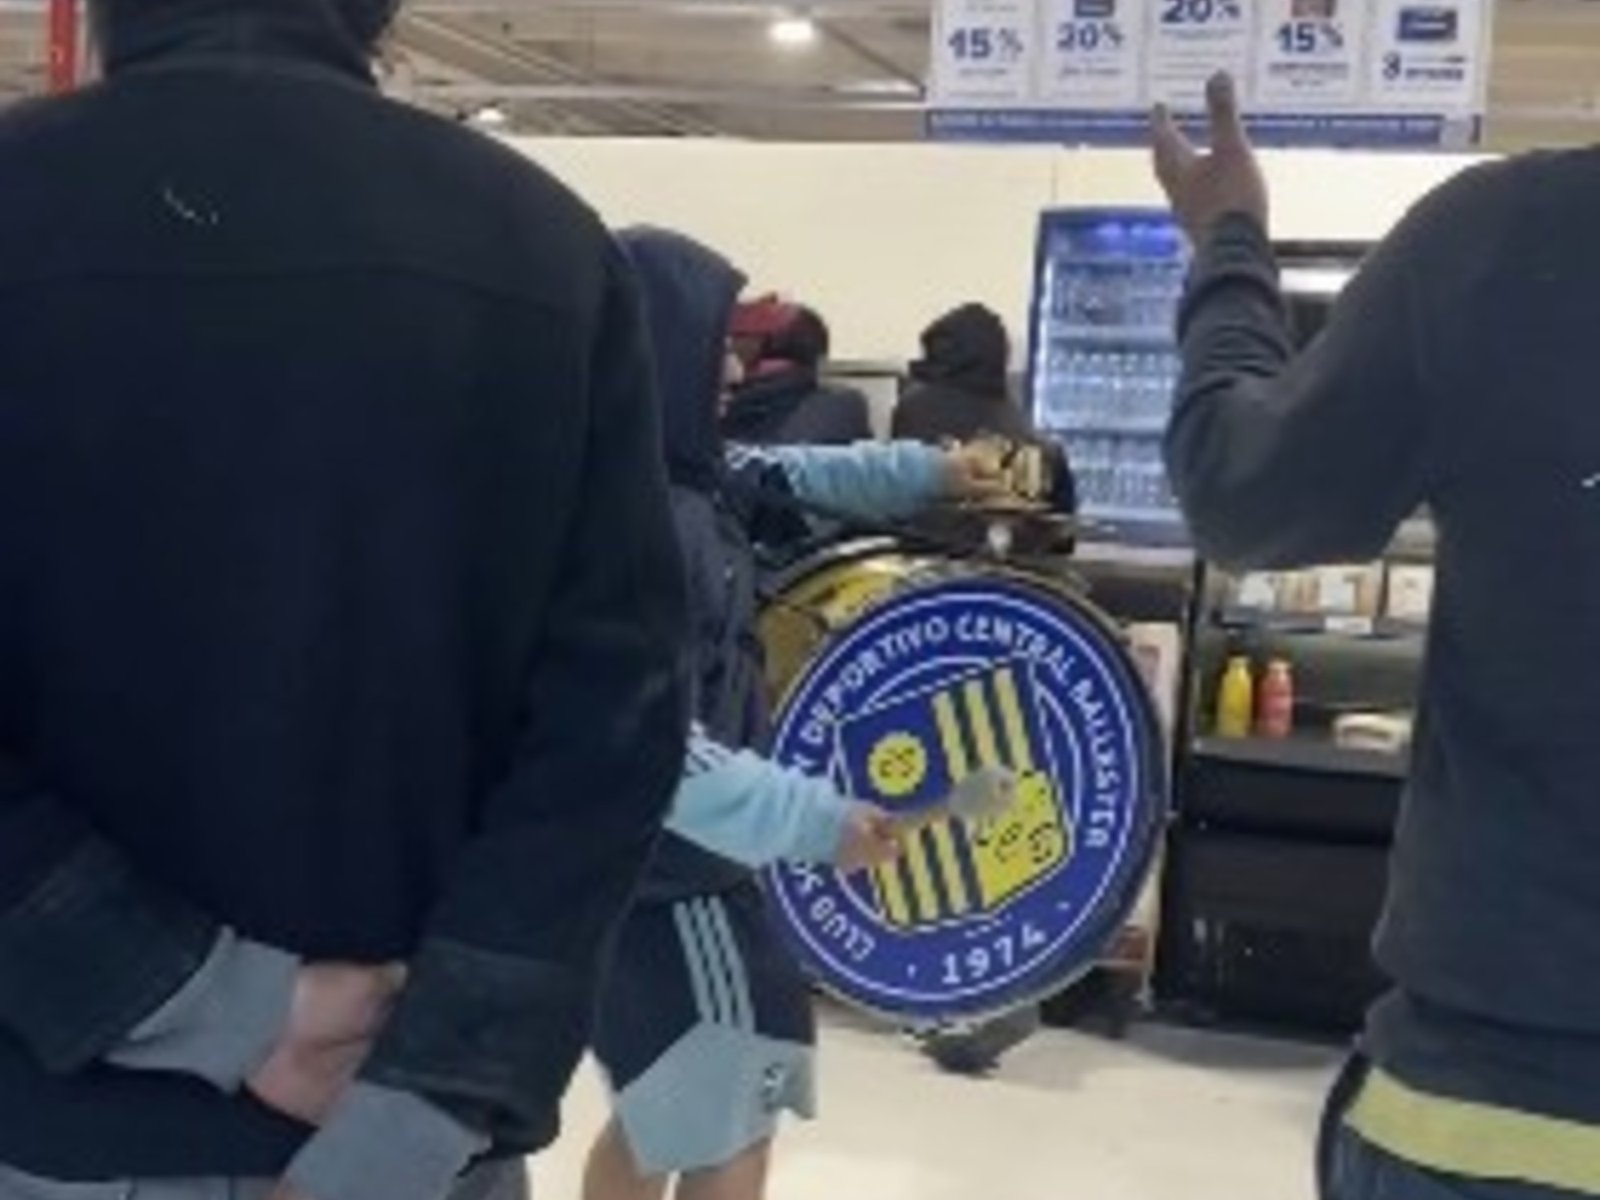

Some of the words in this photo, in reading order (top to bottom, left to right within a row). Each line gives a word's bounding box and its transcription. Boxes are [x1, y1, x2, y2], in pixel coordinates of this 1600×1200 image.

[800, 616, 949, 744] DEPORTIVO
[956, 611, 1076, 685] CENTRAL
[1068, 678, 1122, 848] BALLESTER
[811, 896, 876, 961] CLUB
[941, 922, 1047, 984] 1974
